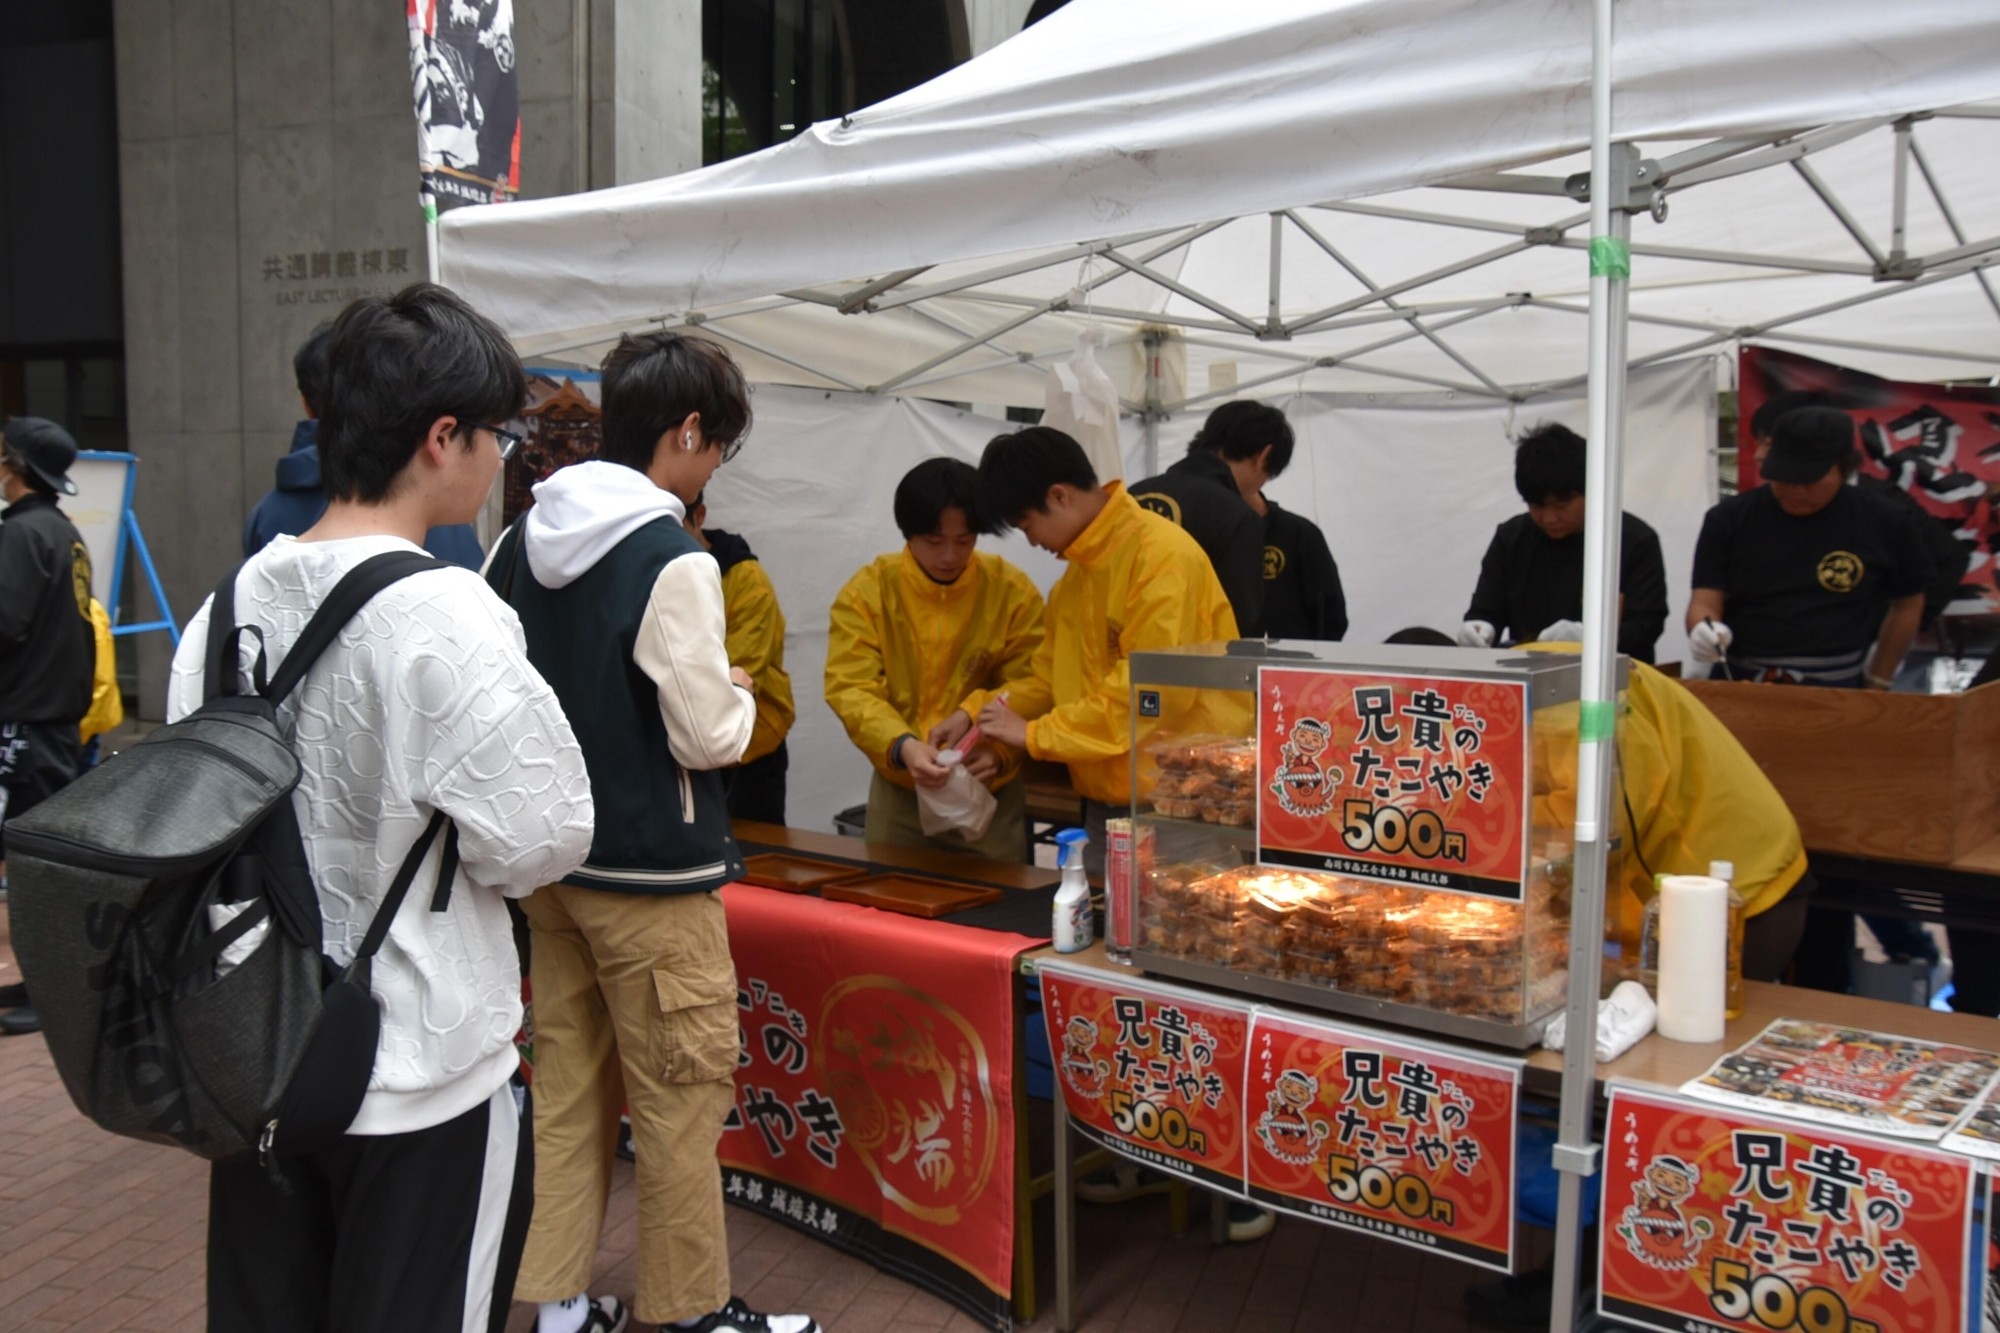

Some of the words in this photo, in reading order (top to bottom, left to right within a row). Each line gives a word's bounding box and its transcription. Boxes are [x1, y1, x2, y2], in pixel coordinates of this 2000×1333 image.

[275, 290, 305, 305] EAST
[1352, 685, 1480, 752] 兄貴の
[1352, 748, 1494, 804] たこやき
[1341, 798, 1468, 864] 500円
[749, 976, 807, 1037] アニキ
[1112, 996, 1213, 1067] 兄貴の
[1114, 1049, 1225, 1110] たこやき
[1341, 1047, 1467, 1130] 兄貴の
[723, 1083, 846, 1169] やき
[1110, 1088, 1207, 1157] 500円
[1336, 1108, 1481, 1178] たこやき
[722, 1173, 764, 1203] 年部
[1327, 1153, 1456, 1227] 500円
[1730, 1129, 1905, 1230] 兄貴の
[1724, 1200, 1922, 1293] たこやき
